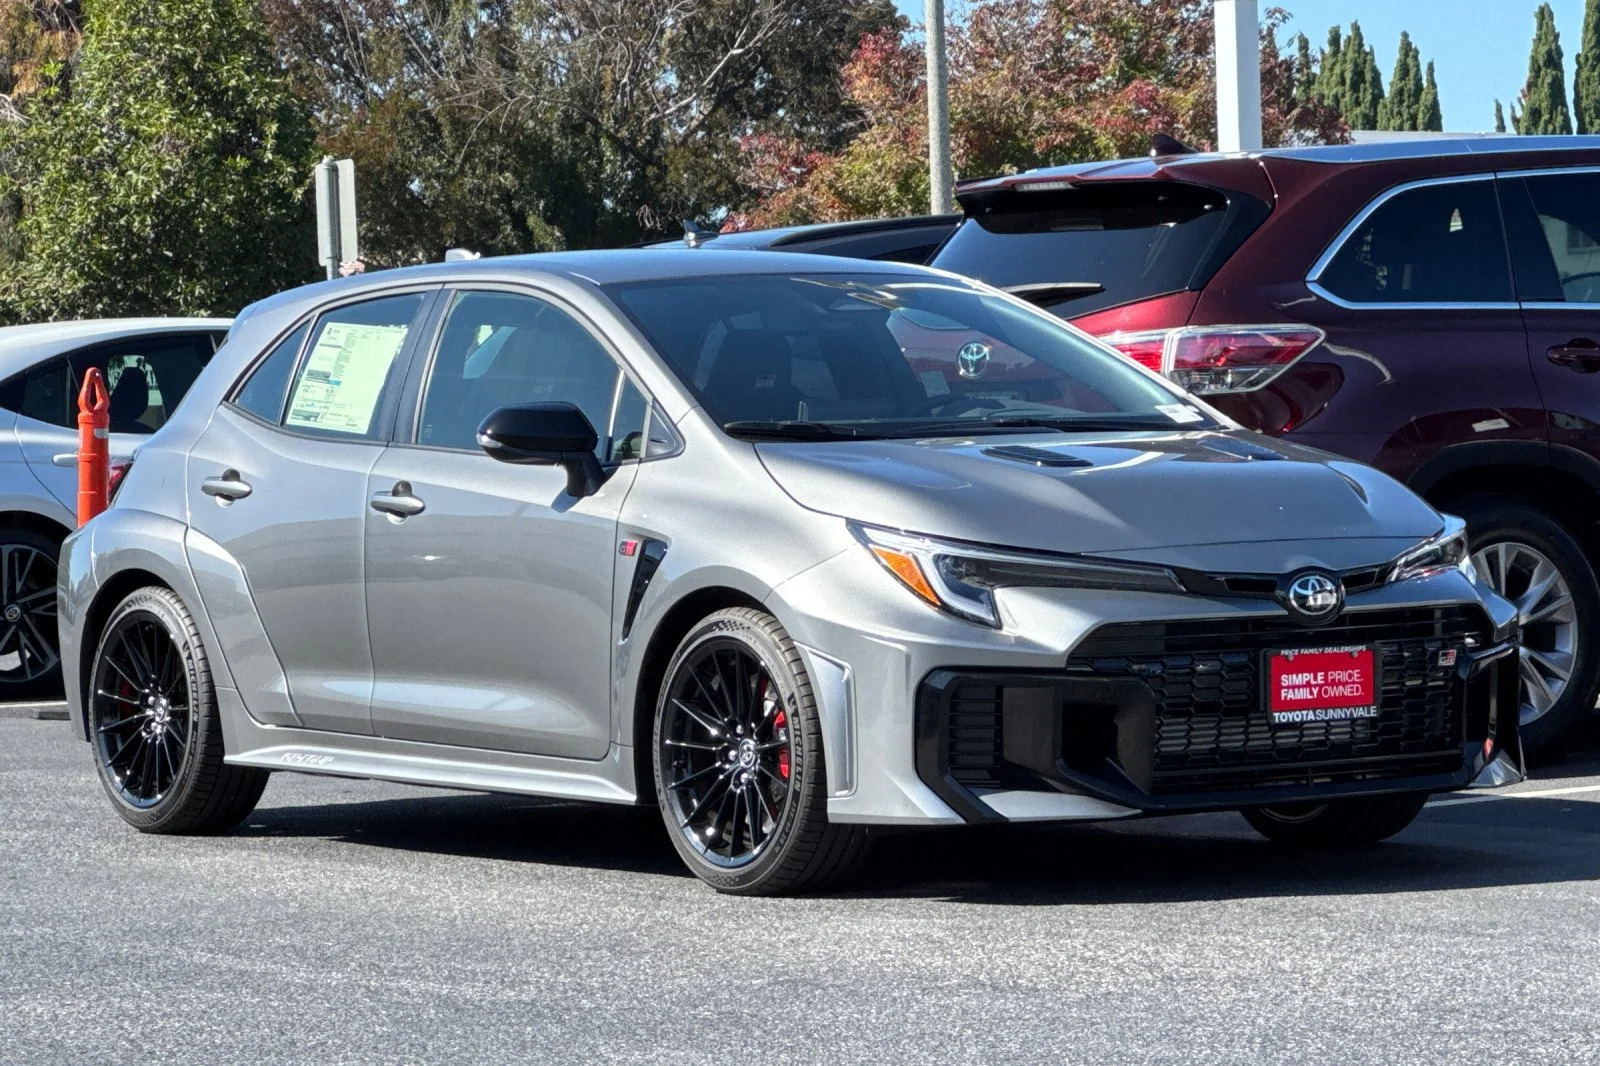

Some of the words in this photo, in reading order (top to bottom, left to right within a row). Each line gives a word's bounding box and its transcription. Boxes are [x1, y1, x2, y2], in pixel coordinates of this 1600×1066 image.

[1300, 647, 1322, 655] FAMILY
[1323, 645, 1367, 654] DEALERSHIPS
[1281, 672, 1325, 686] SIMPLE
[1327, 670, 1364, 683] PRICE.
[188, 659, 198, 721] MICHELIN
[1281, 687, 1319, 700] FAMILY
[1321, 684, 1364, 698] OWNED.
[1273, 711, 1315, 723] TOYOTA
[1315, 706, 1377, 720] SUNNYVALE
[792, 717, 803, 792] MICHELIN
